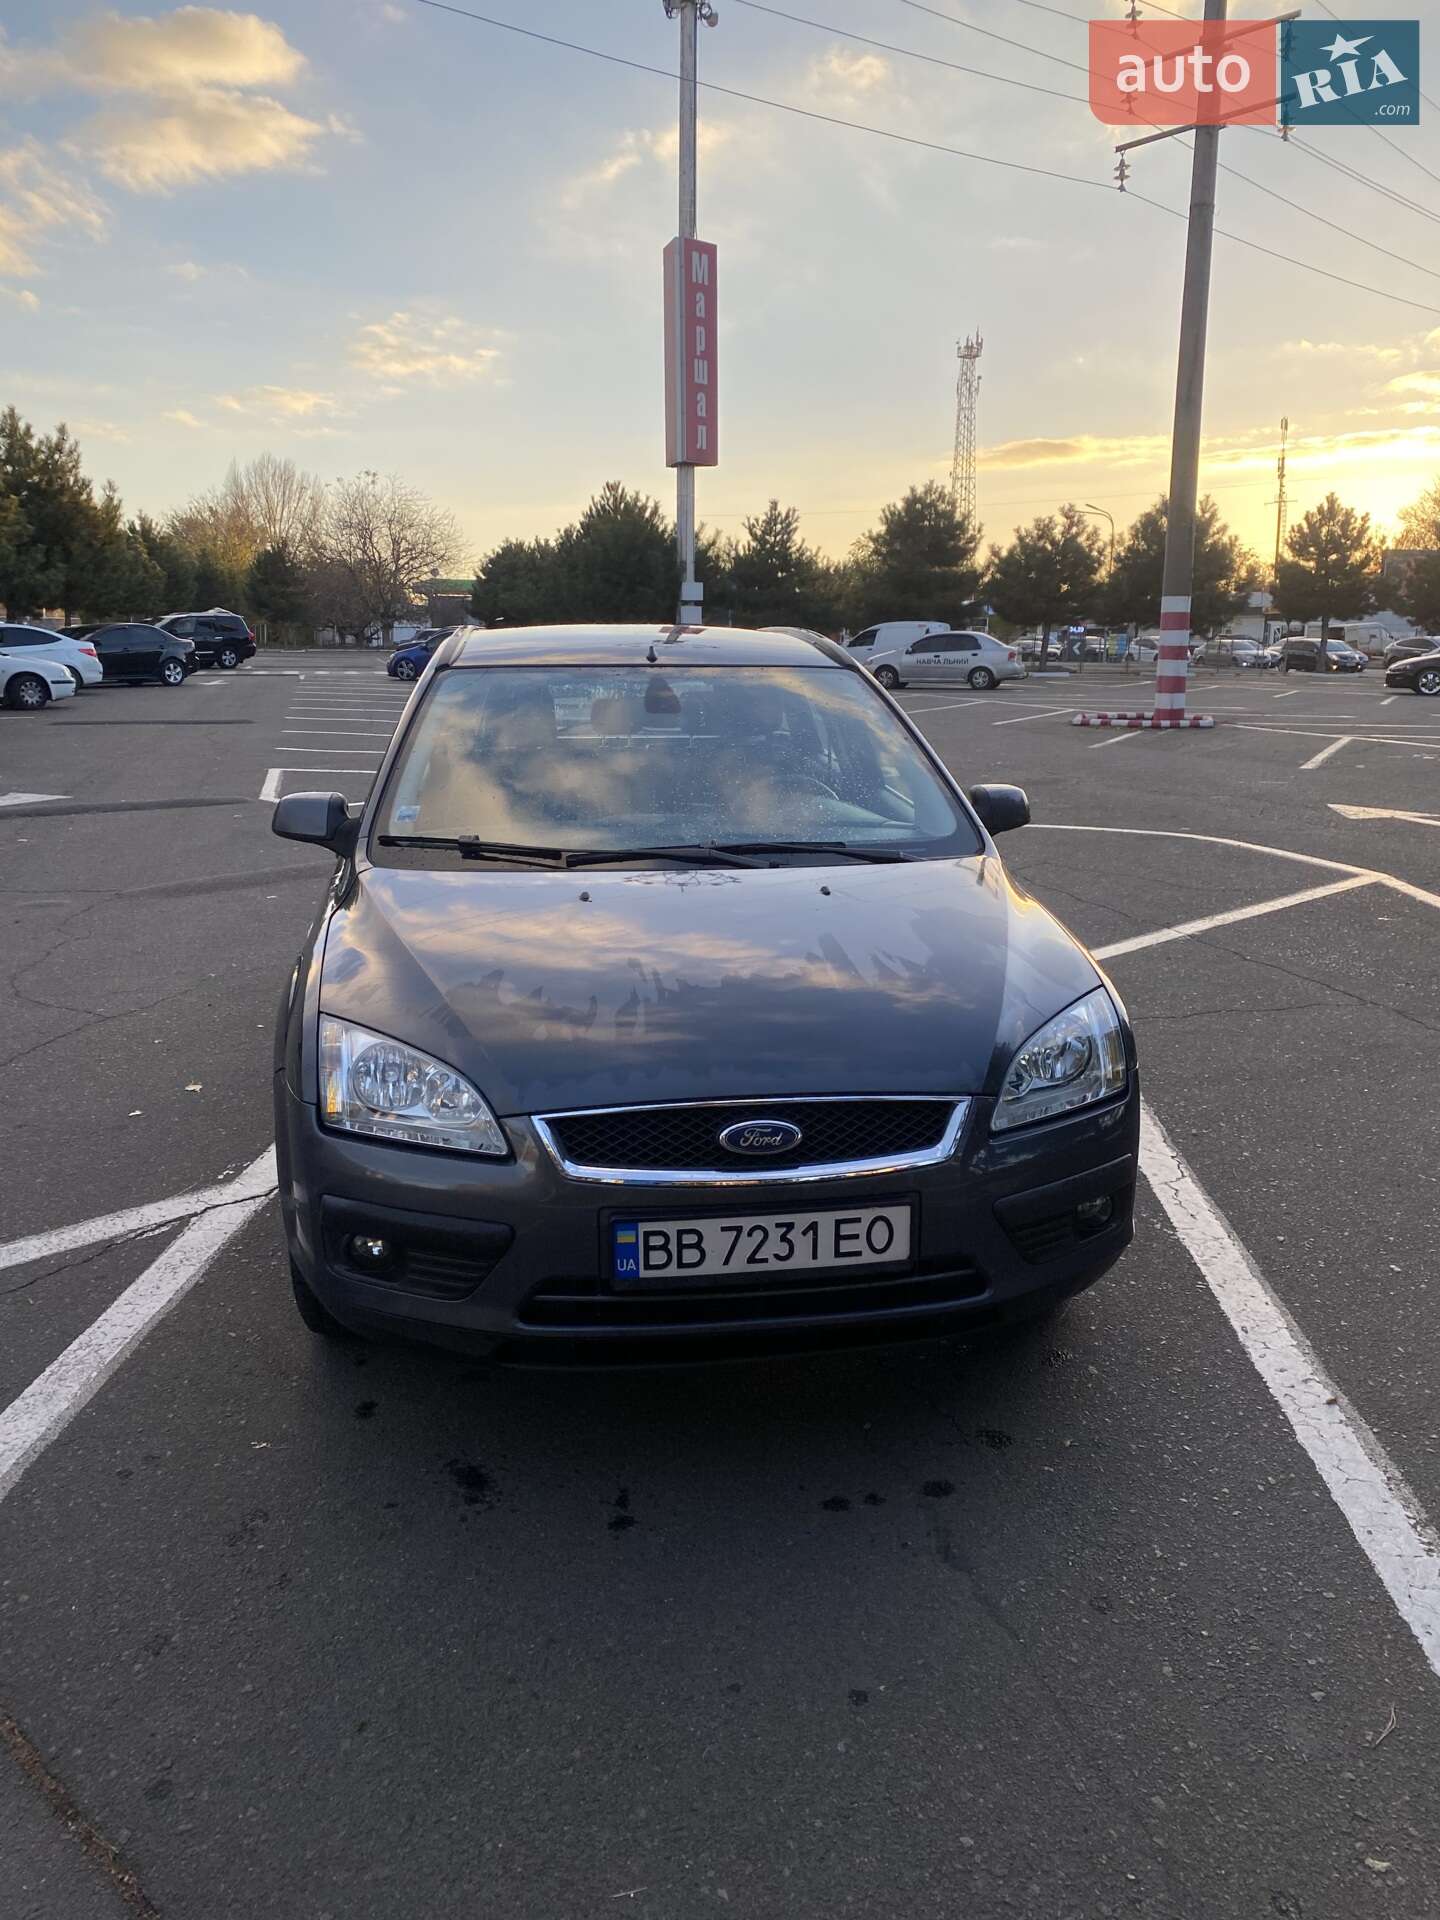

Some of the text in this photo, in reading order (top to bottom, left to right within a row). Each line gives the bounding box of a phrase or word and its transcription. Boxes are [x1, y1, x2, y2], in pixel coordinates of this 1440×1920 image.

[691, 251, 709, 450] Маршал
[739, 1128, 784, 1147] Ford
[643, 1215, 894, 1271] BB 7231 EO
[617, 1258, 637, 1272] UA
